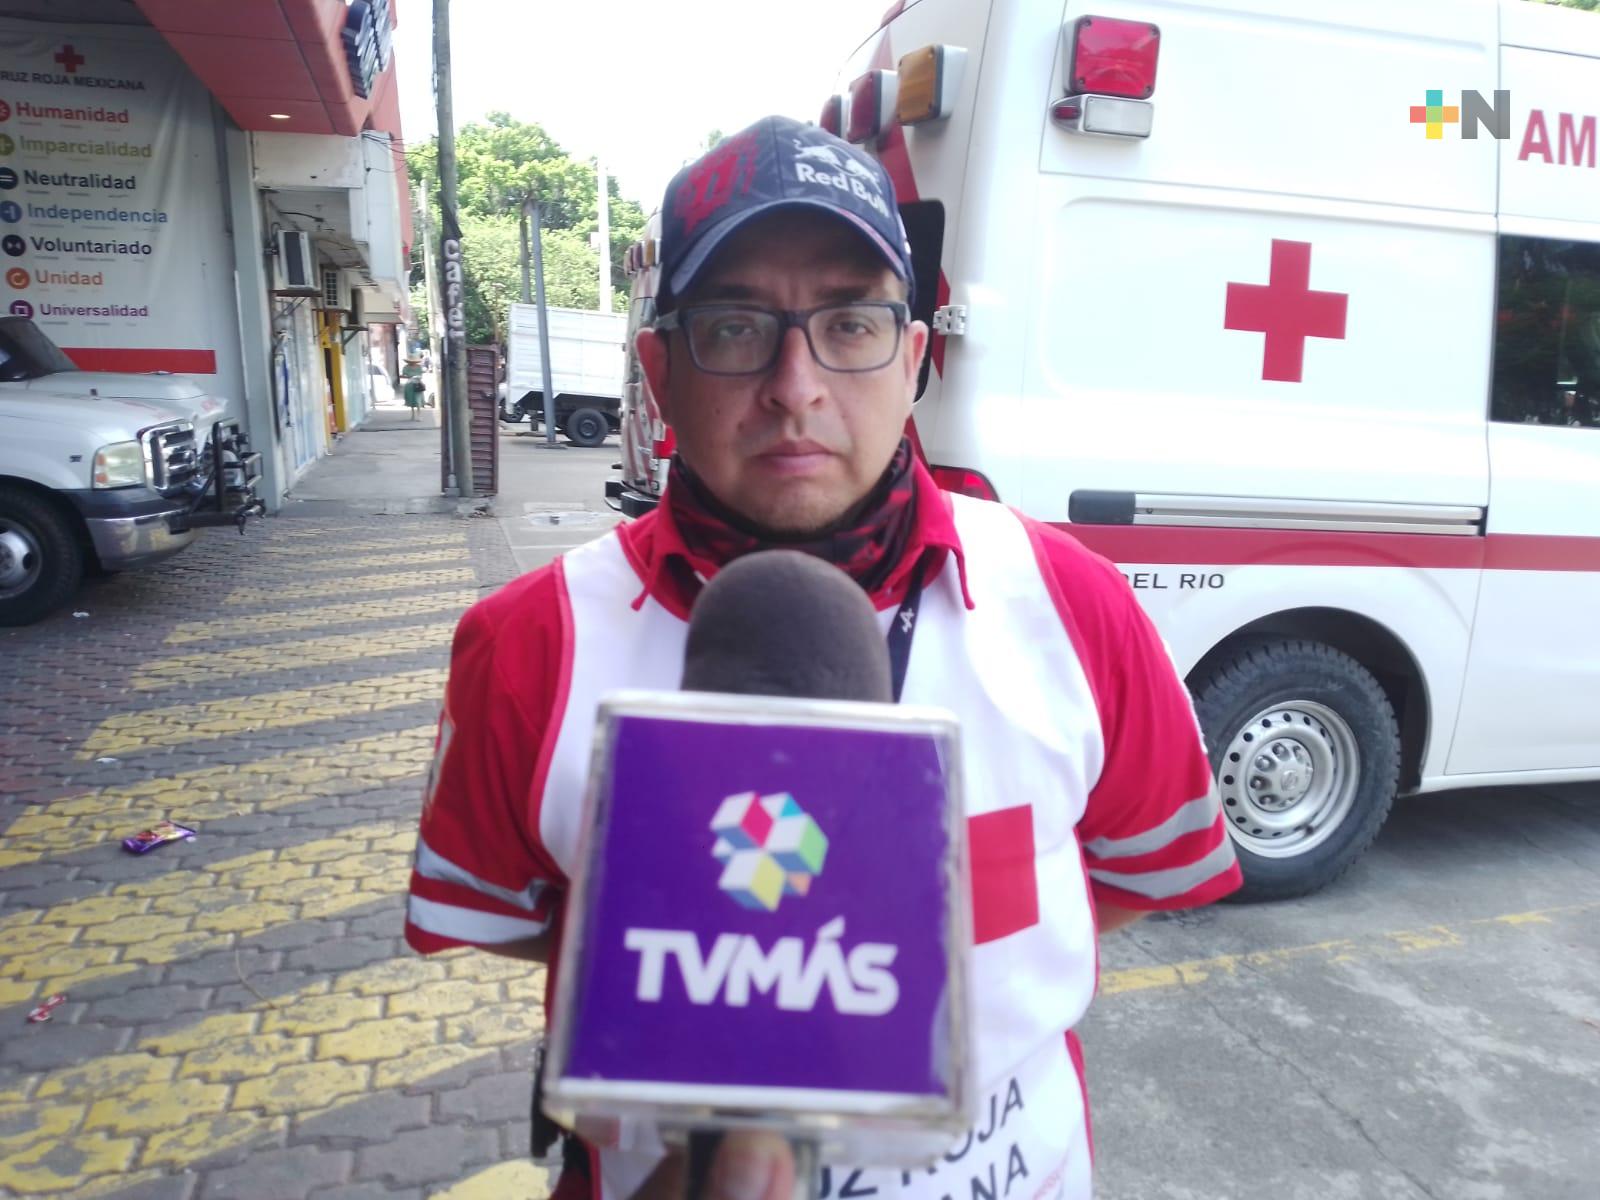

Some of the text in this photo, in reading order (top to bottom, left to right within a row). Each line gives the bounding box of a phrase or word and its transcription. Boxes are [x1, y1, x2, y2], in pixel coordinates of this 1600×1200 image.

[31, 73, 70, 86] ROJA
[73, 76, 146, 91] MEXICANA
[16, 101, 129, 124] Humanidad
[20, 136, 152, 160] Imparcialidad
[1517, 109, 1597, 168] AM
[24, 170, 136, 190] Neutralidad
[28, 203, 168, 224] Independencia
[30, 236, 152, 256] Voluntariado
[36, 270, 104, 287] Unidad
[40, 303, 149, 318] Universalidad
[1121, 573, 1225, 589] EL RIO
[939, 1143, 1029, 1200] NA
